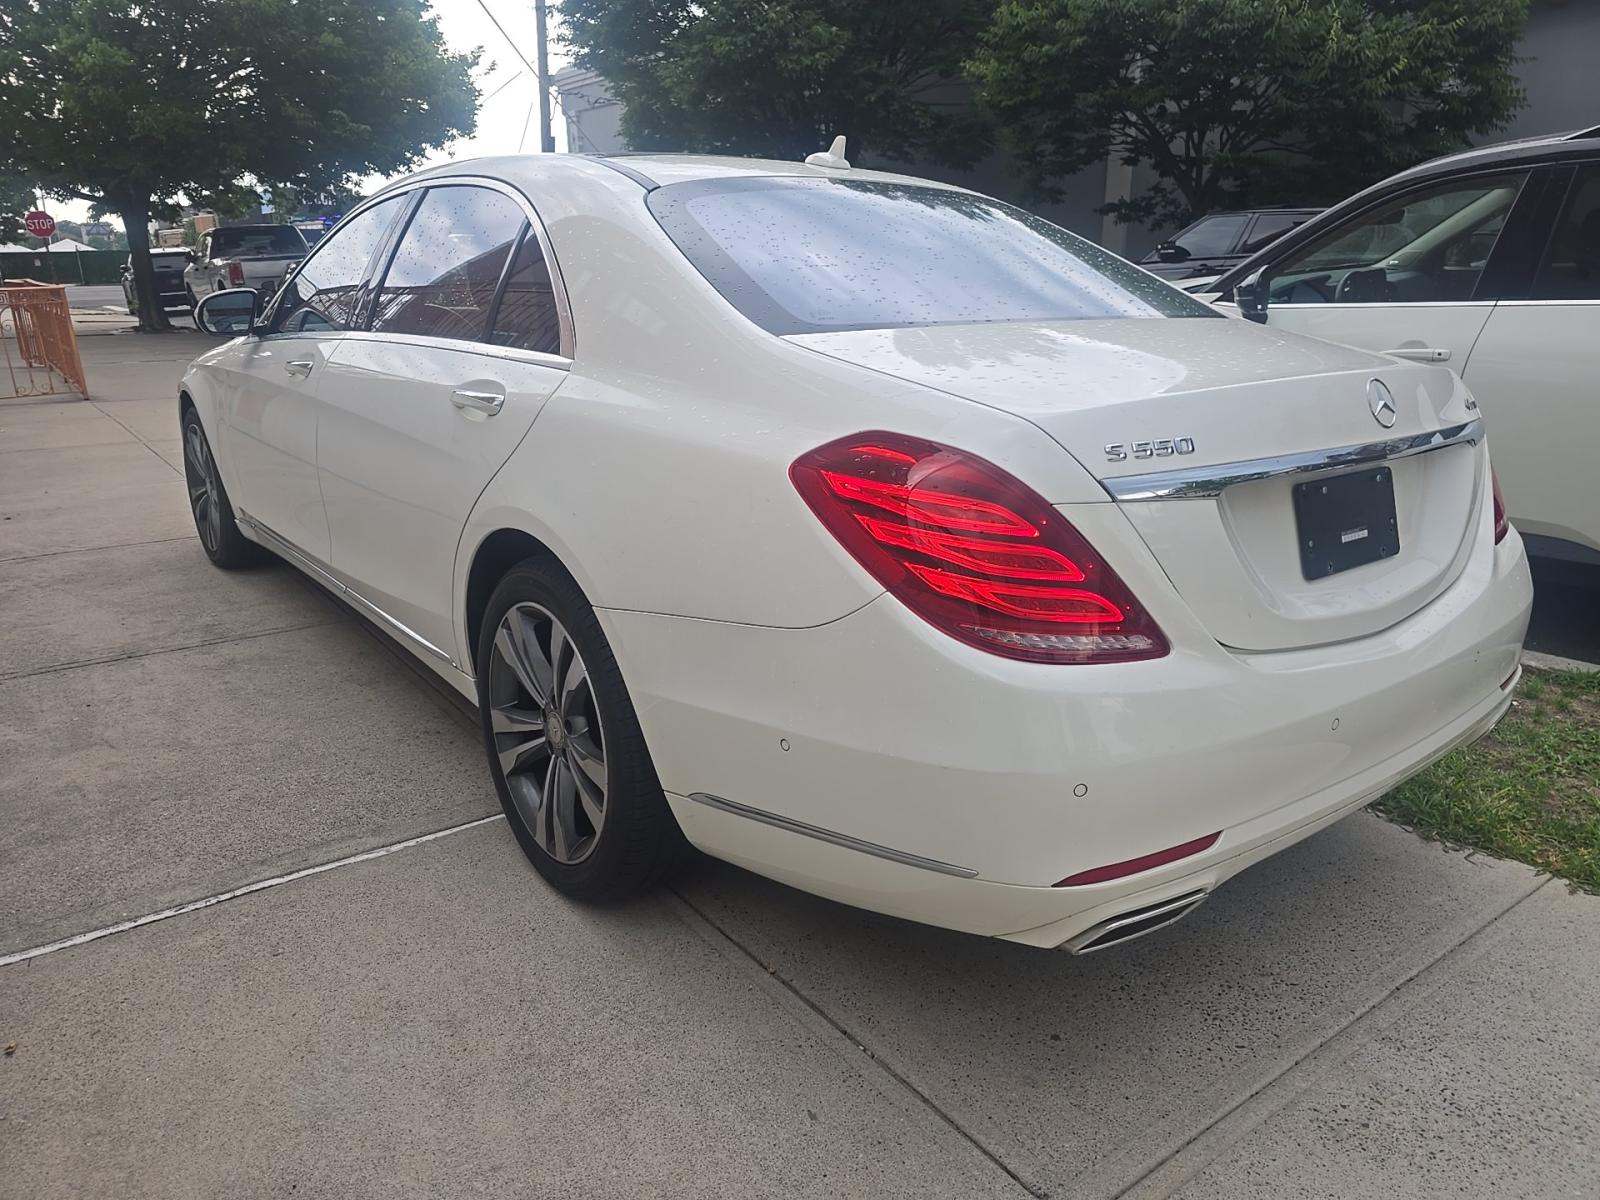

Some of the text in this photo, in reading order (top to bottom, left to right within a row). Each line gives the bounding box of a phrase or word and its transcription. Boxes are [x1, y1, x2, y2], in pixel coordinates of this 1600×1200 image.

[27, 219, 53, 230] STOP
[1104, 436, 1195, 462] S 550
